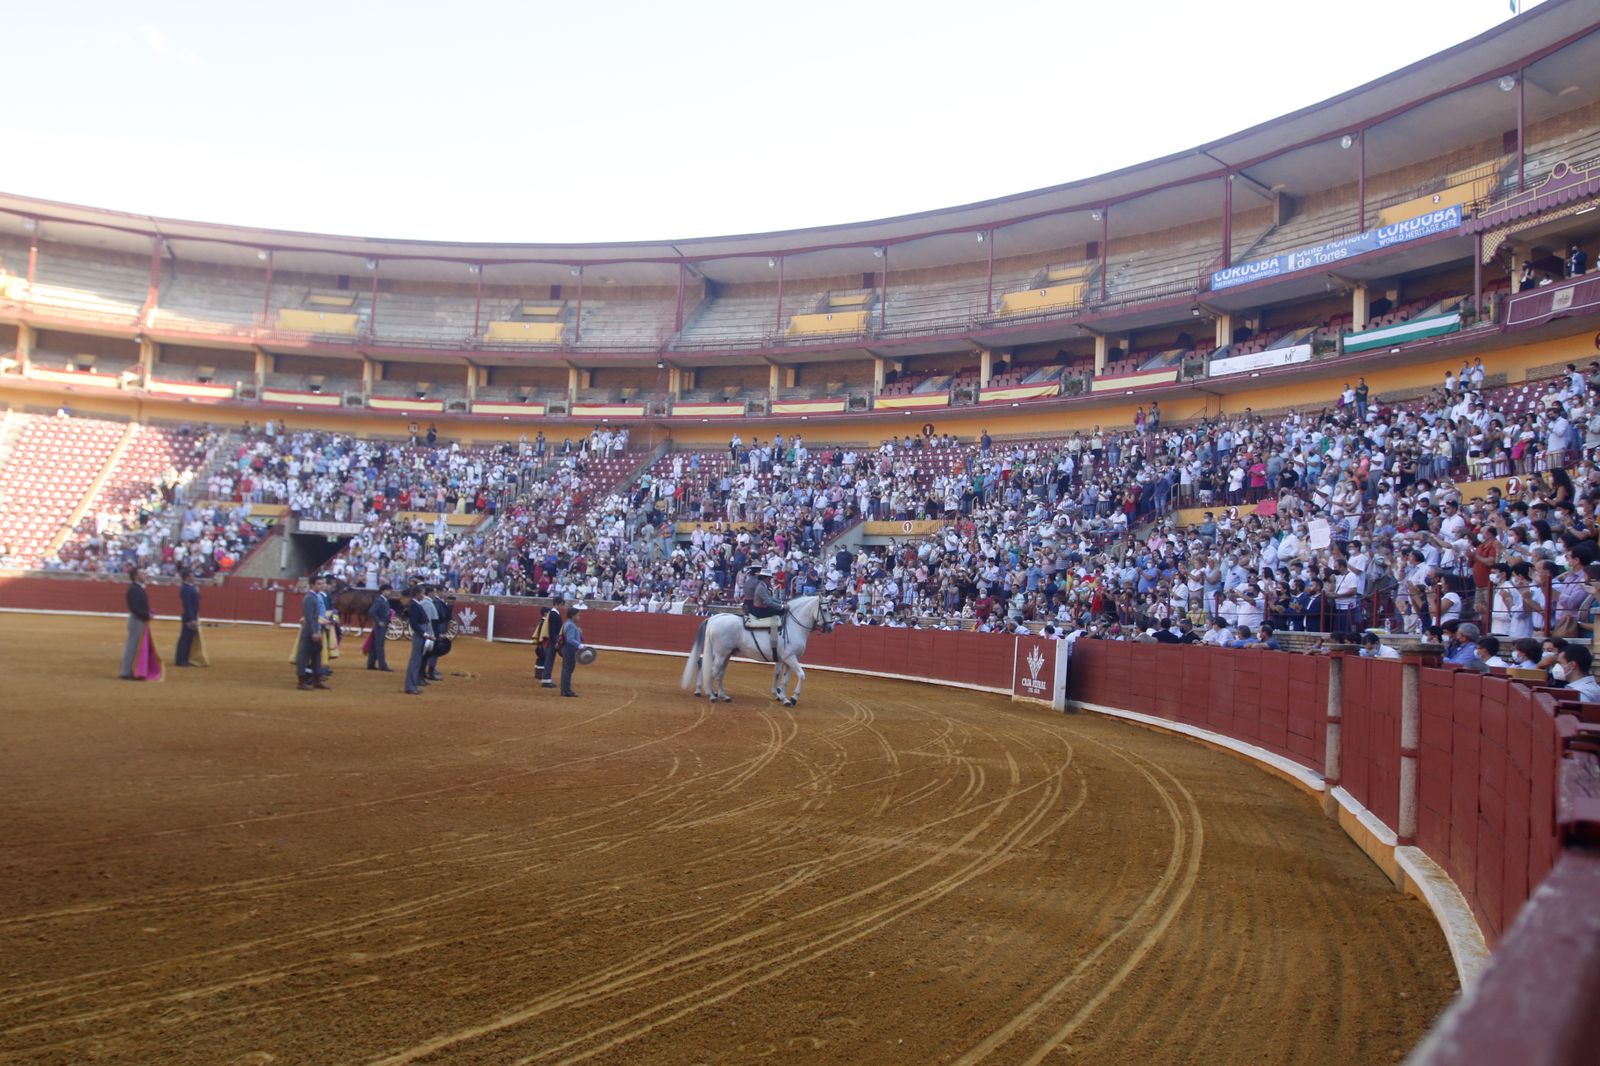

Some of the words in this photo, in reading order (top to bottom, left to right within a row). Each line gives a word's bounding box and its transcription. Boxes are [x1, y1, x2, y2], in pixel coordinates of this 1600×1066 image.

[1378, 233, 1405, 246] WORLD
[1405, 223, 1440, 239] HERITAGE
[1441, 219, 1457, 229] SITE
[1297, 256, 1311, 268] de
[1313, 248, 1348, 264] Torres
[1509, 479, 1517, 495] 2
